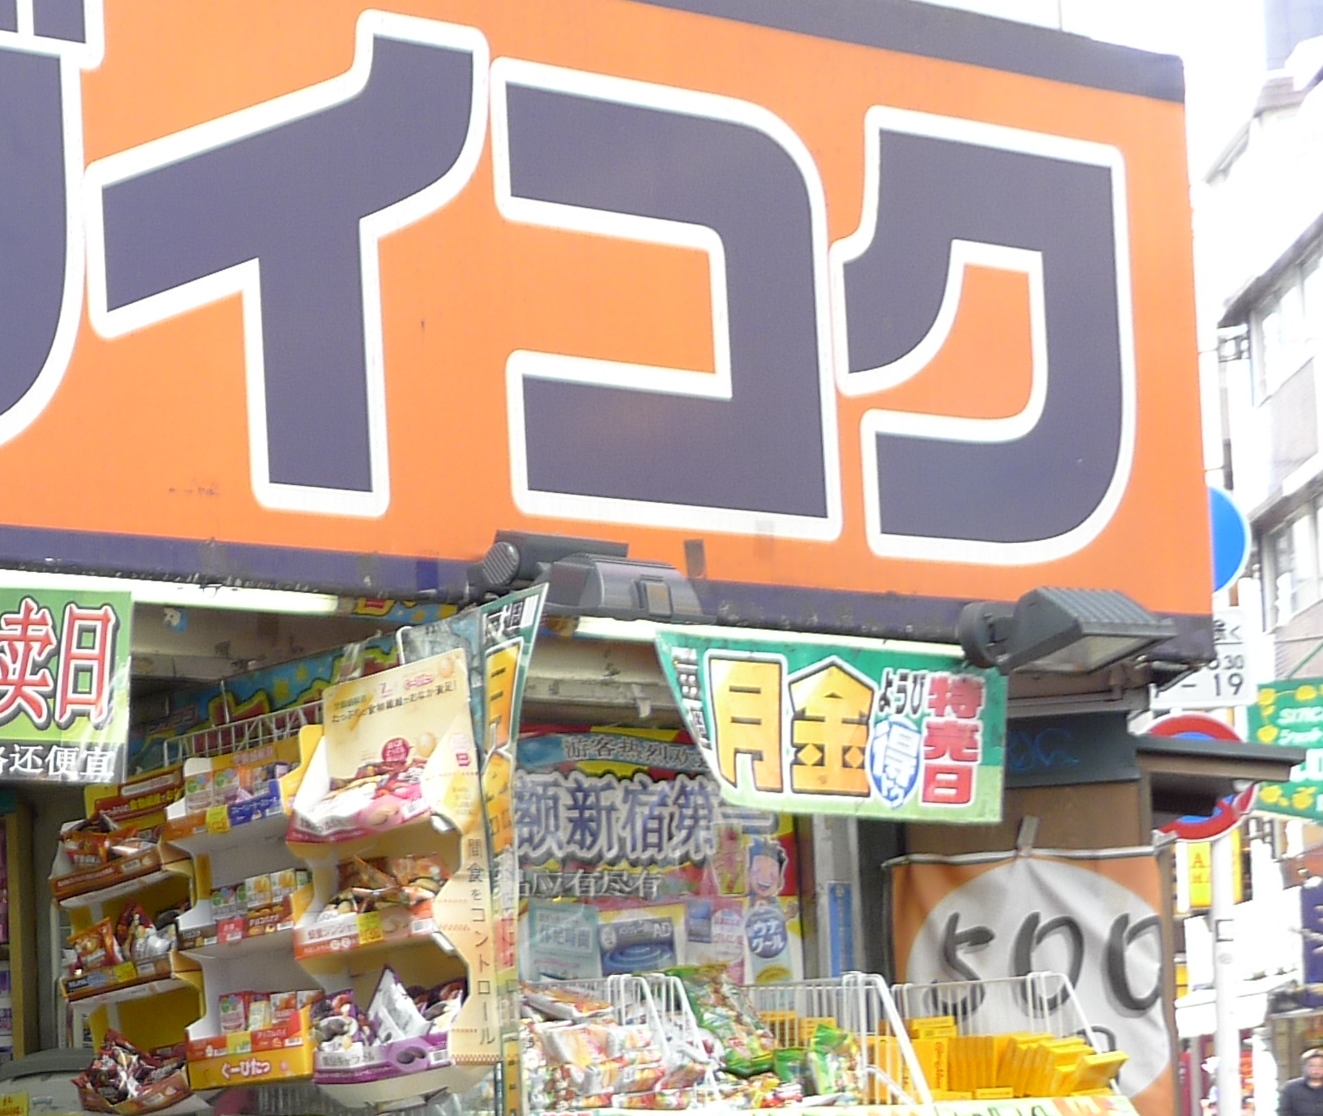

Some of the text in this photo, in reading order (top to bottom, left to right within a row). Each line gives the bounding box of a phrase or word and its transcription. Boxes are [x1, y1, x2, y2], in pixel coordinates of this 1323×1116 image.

[709, 653, 875, 796] 月金
[923, 673, 985, 805] 特売日
